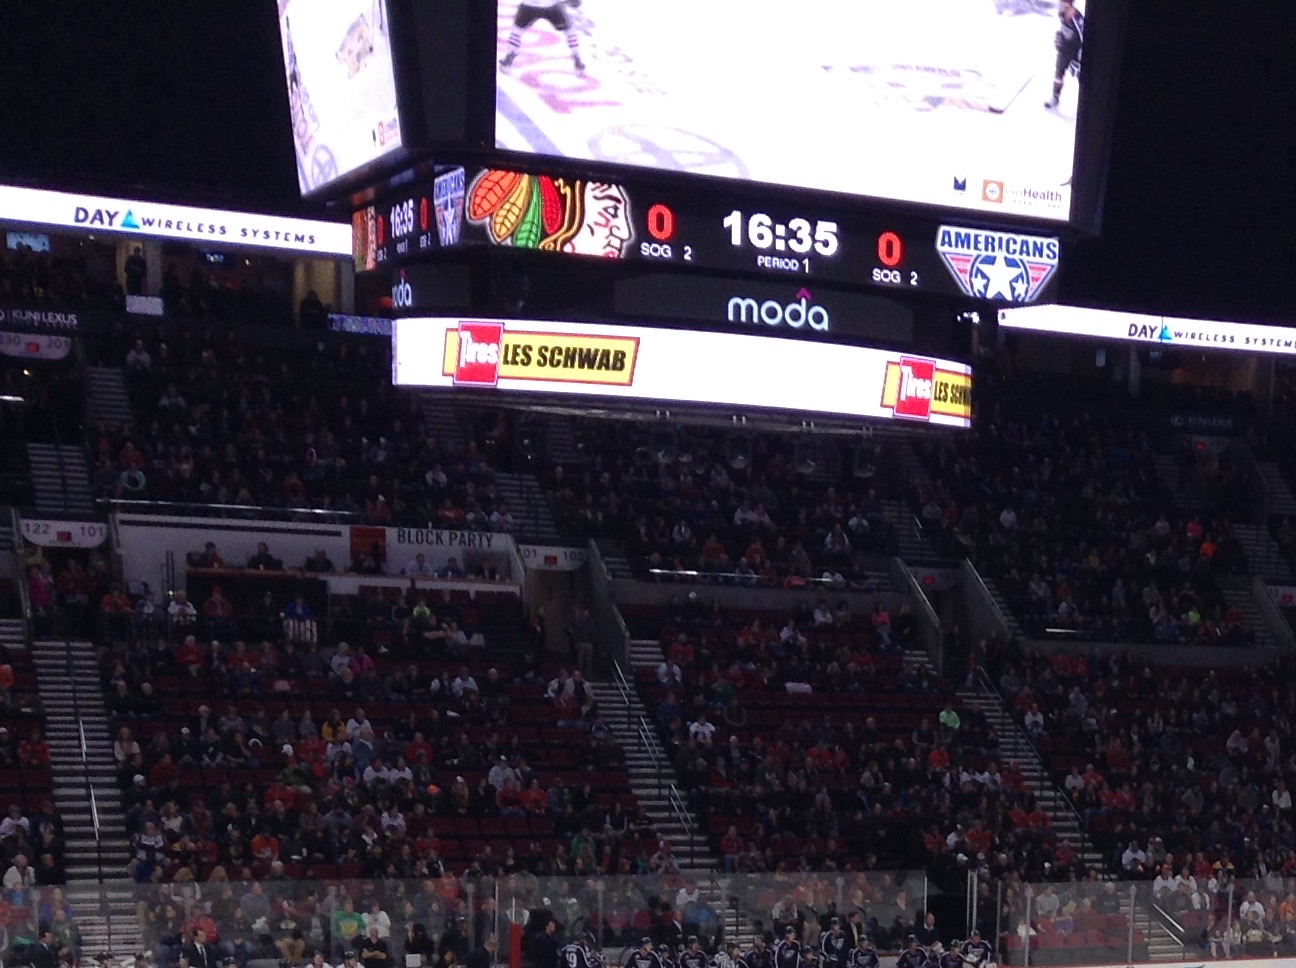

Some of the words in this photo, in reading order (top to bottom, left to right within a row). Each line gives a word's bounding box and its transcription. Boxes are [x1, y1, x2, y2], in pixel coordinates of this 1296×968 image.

[74, 207, 119, 226] DAY
[141, 217, 227, 235] WIRELESS
[241, 228, 316, 244] SYSTEMS
[648, 204, 673, 239] 0
[724, 210, 839, 259] 16:35
[641, 242, 672, 258] SOG
[683, 245, 693, 260] 2
[878, 231, 901, 265] 0
[939, 230, 1058, 259] AMERICANS
[757, 255, 799, 271] PERIOD
[803, 257, 811, 273] 1
[872, 267, 902, 282] SOG
[909, 270, 918, 285] 2
[728, 297, 829, 331] moda
[1128, 323, 1157, 338] DAY
[1174, 332, 1235, 344] WIRELESS
[460, 331, 500, 368] Tires
[503, 343, 533, 366] LES
[537, 346, 627, 372] SCHWAB
[901, 366, 935, 402] Tires
[934, 380, 949, 403] LES
[397, 530, 443, 545] BLOCK
[449, 531, 493, 547] PARTY
